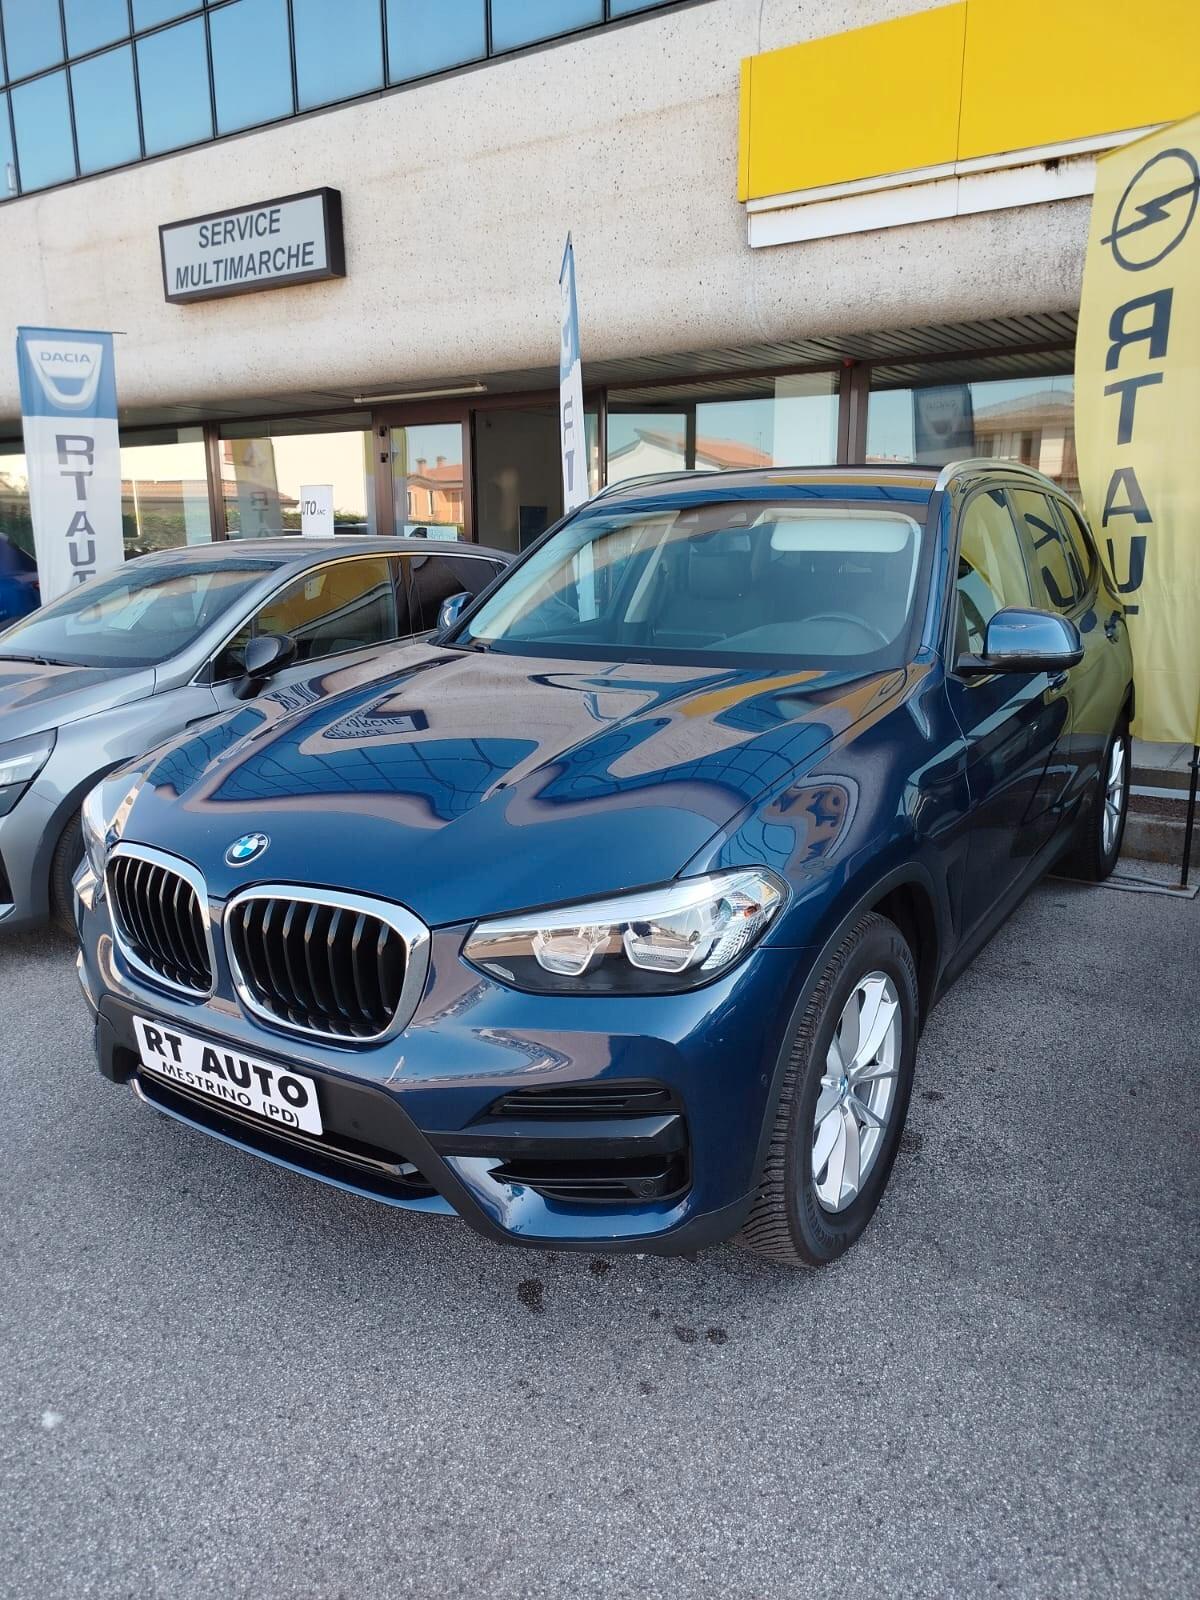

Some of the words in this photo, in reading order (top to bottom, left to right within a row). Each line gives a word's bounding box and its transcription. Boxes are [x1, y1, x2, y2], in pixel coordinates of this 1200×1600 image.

[198, 208, 281, 249] SERVICE
[175, 241, 315, 290] MULTIMARCHE
[40, 351, 92, 364] DACIA
[142, 1023, 182, 1063] RT
[201, 1046, 309, 1109] AUTO
[162, 1061, 252, 1107] MESTRINO
[262, 1101, 300, 1128] (PD)
